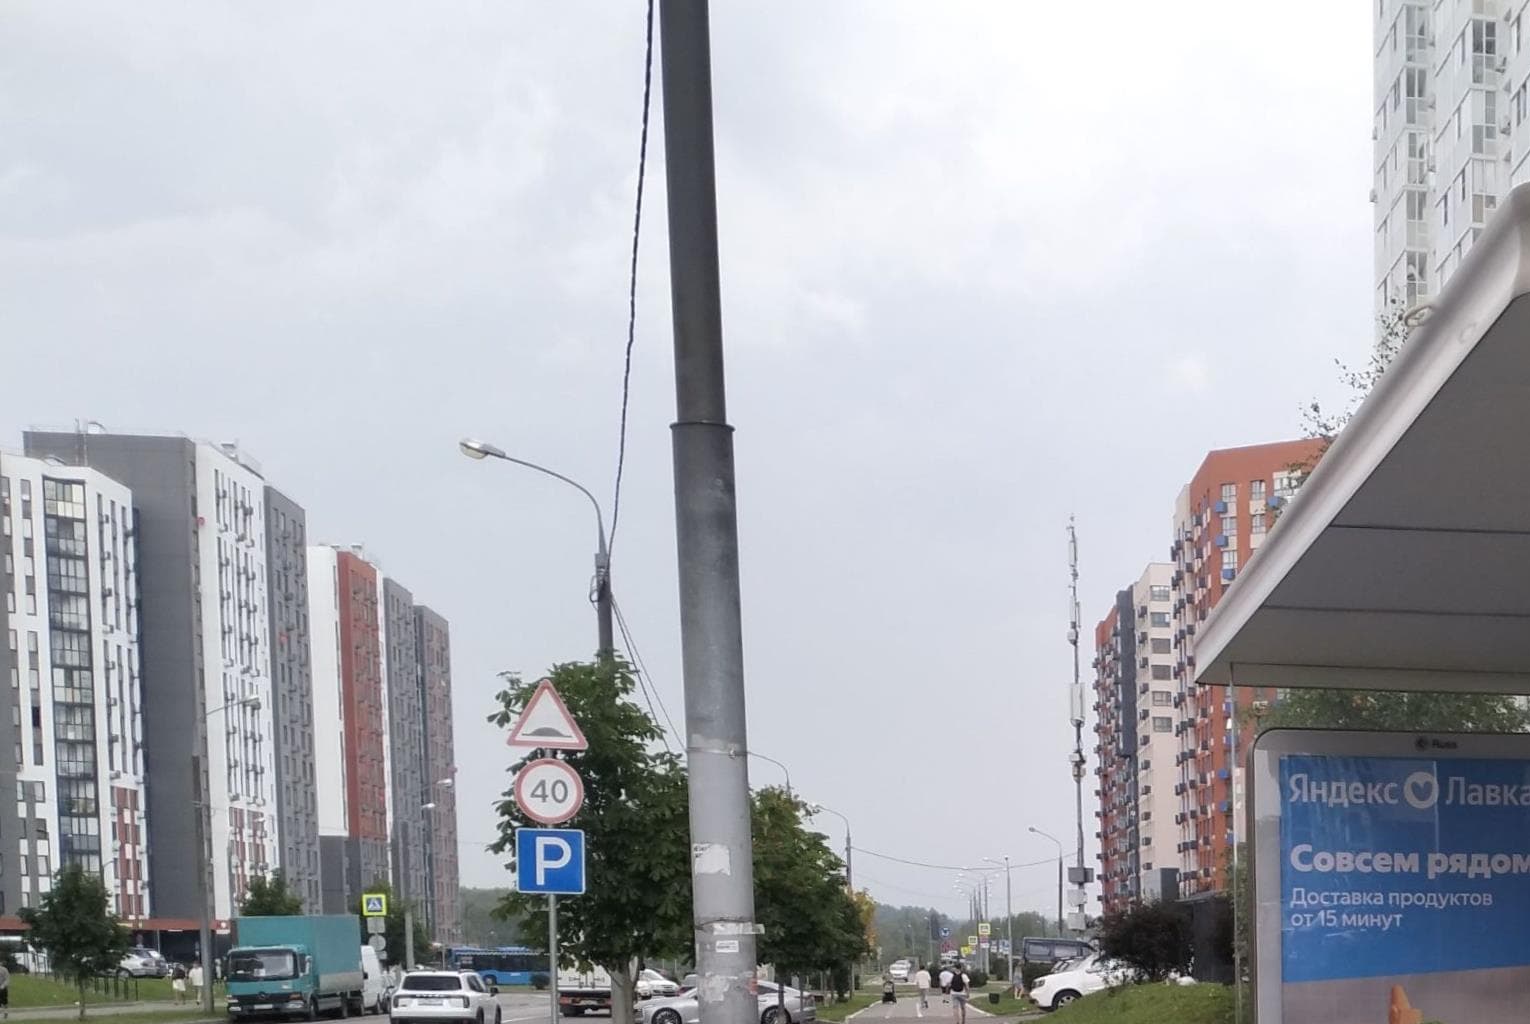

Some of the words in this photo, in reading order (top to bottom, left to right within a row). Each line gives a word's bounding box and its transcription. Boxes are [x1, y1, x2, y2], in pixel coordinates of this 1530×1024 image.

[530, 779, 569, 804] 40
[1289, 773, 1400, 808] Яндекс
[535, 835, 572, 886] P
[1290, 844, 1419, 873] Совсем
[1290, 888, 1384, 908] Доставка
[1388, 892, 1493, 908] продуктов
[1290, 914, 1313, 927] от
[1316, 910, 1337, 927] 15
[1342, 913, 1403, 929] минут
